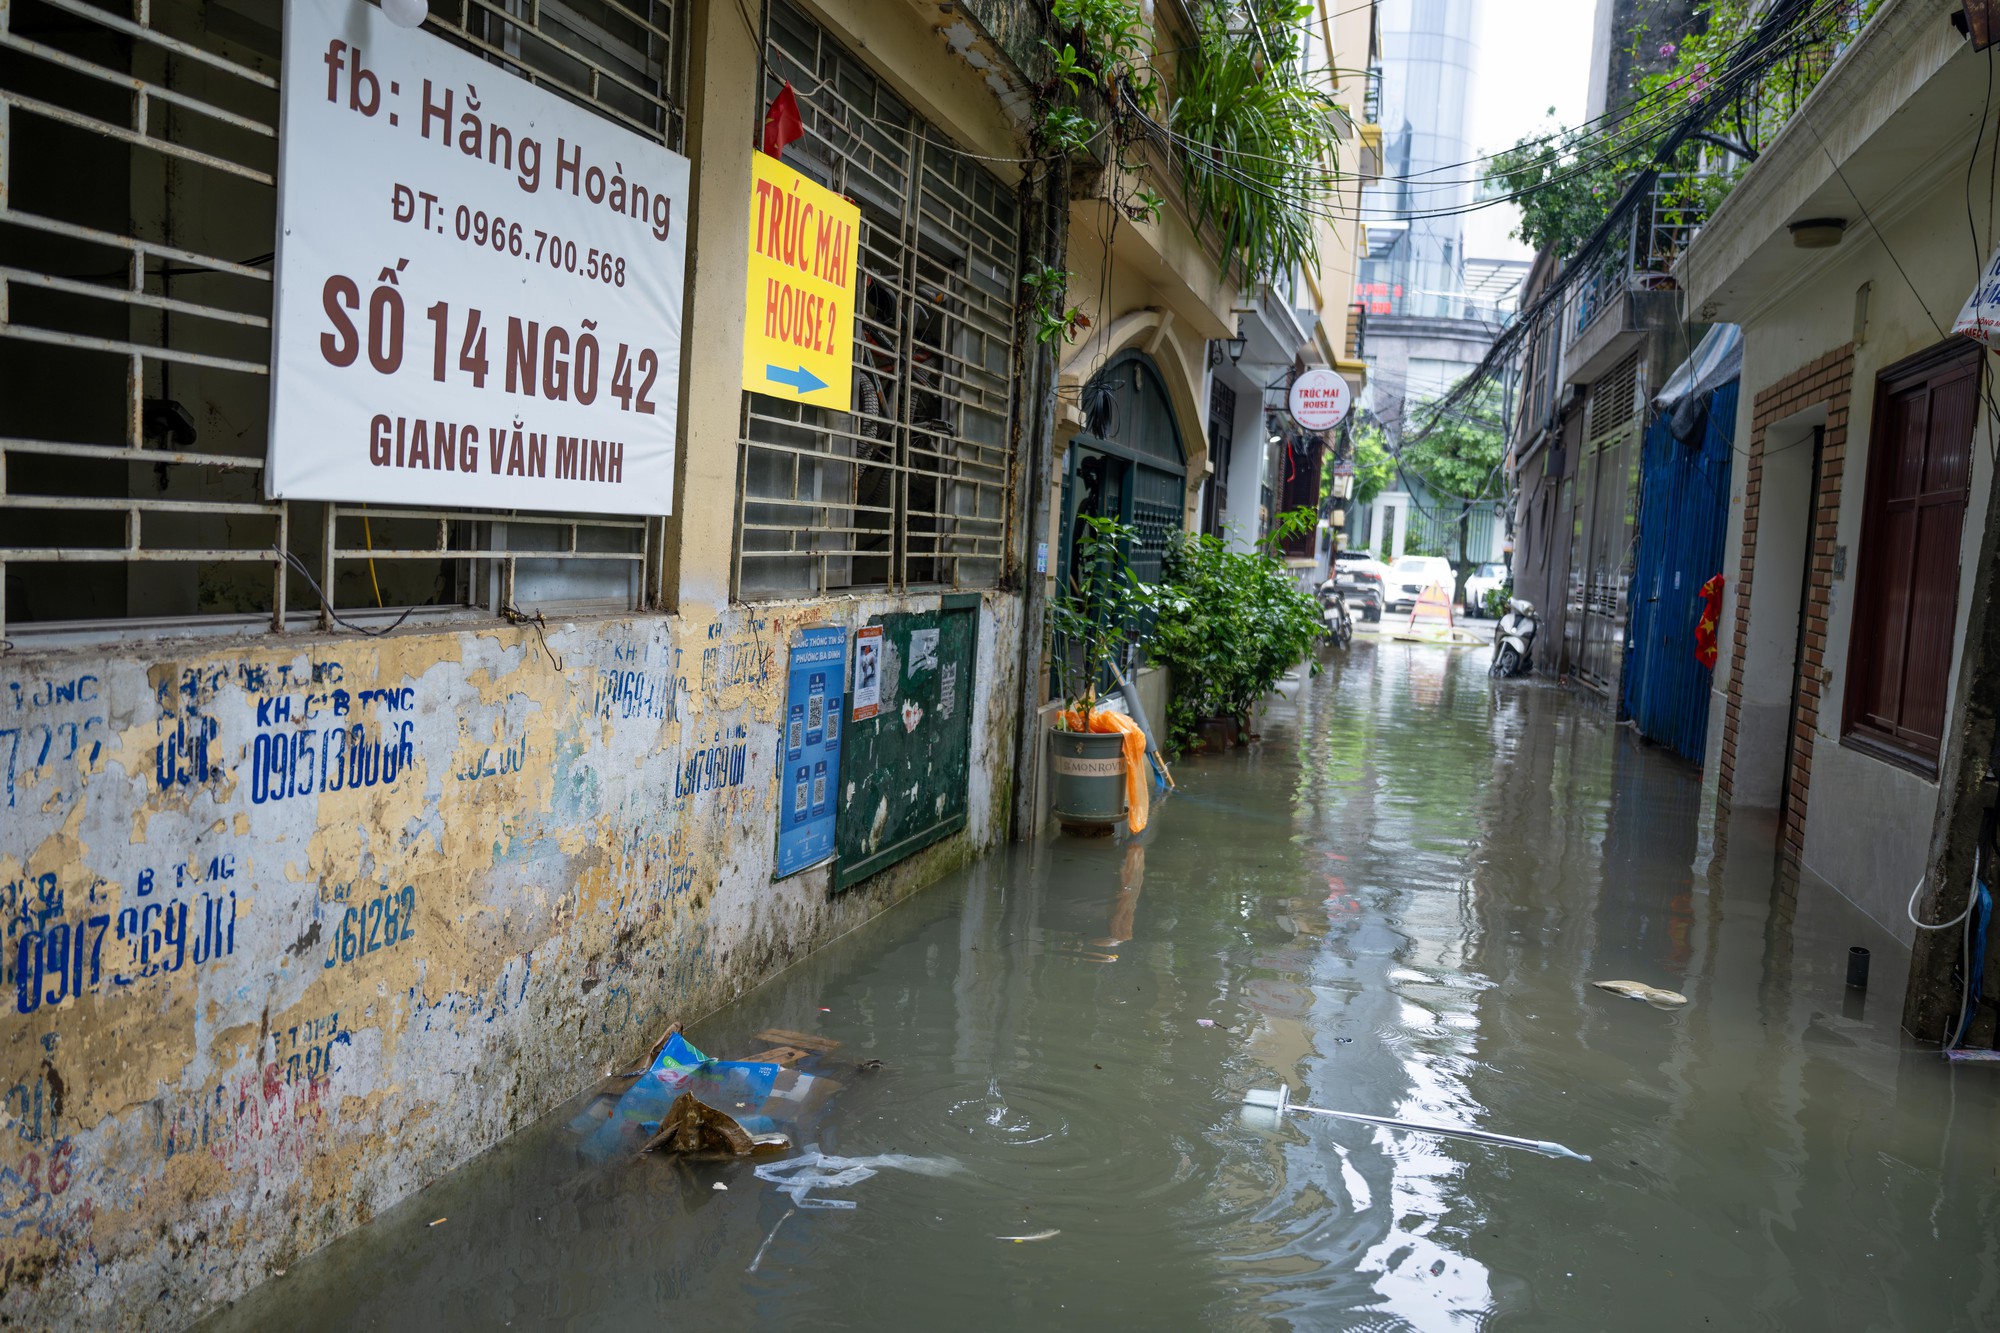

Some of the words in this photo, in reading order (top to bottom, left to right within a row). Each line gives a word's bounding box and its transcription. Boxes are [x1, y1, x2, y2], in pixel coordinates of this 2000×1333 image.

[324, 39, 399, 127] fb:
[421, 79, 542, 194] Hằng
[555, 137, 671, 241] Hoàng
[391, 182, 444, 234] ĐT:
[455, 204, 626, 288] 0966.700.568
[756, 178, 813, 277] TRÚC
[815, 208, 851, 289] MAI
[319, 258, 410, 374] SỐ
[427, 299, 489, 389] 14
[505, 317, 600, 406] NGÕ
[610, 343, 659, 415] 42
[765, 277, 823, 353] HOUSE
[825, 302, 837, 355] 2
[1322, 389, 1340, 398] MAI
[369, 413, 479, 473] GIANG
[488, 420, 548, 477] VĂN
[554, 437, 624, 483] MINH
[819, 651, 828, 660] BA
